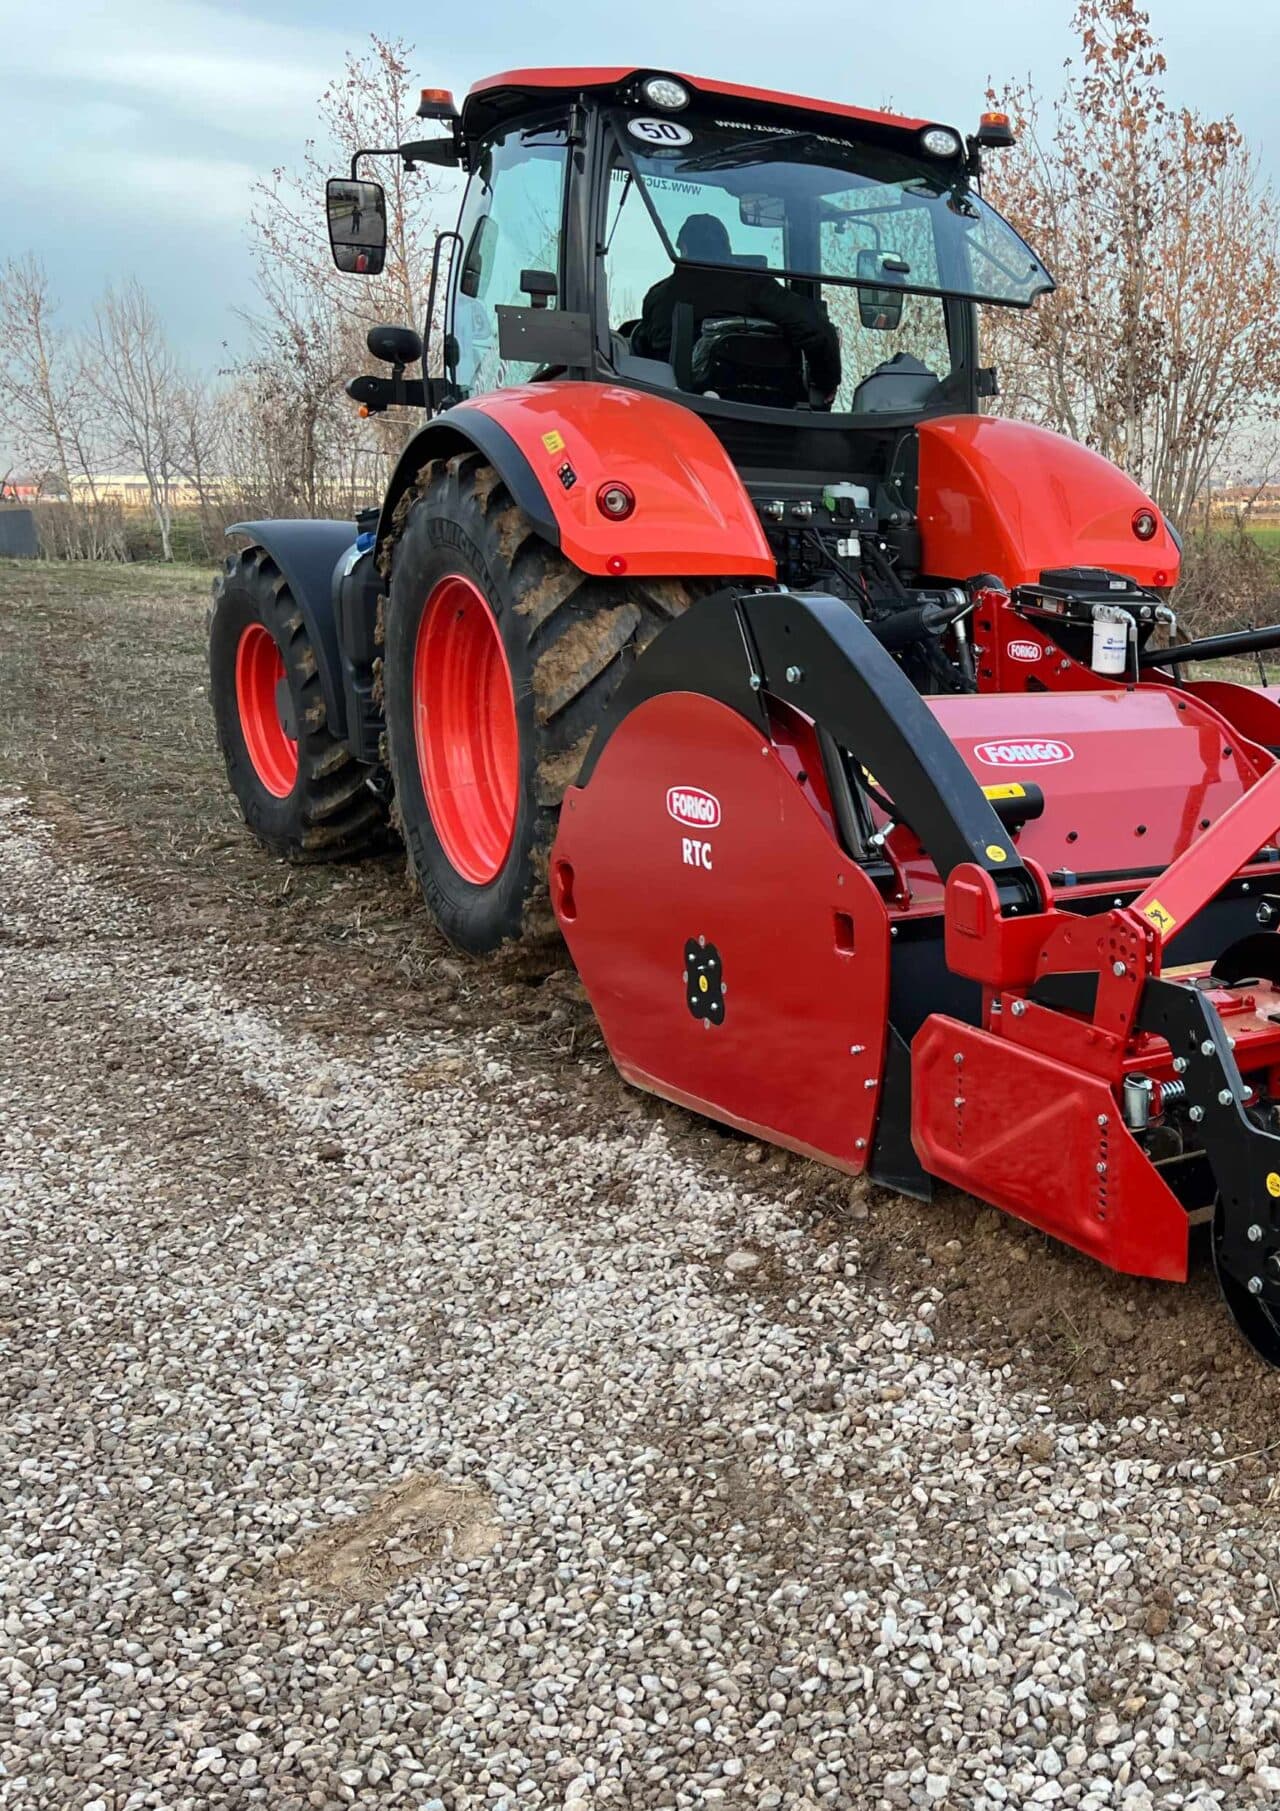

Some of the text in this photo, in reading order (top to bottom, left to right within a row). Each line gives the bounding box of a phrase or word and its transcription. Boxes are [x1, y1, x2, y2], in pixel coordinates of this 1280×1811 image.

[637, 122, 682, 141] 50
[1011, 644, 1039, 659] FORIGO
[983, 743, 1064, 763] FORIGO
[672, 792, 715, 823] FORIGO
[682, 838, 713, 870] RTC
